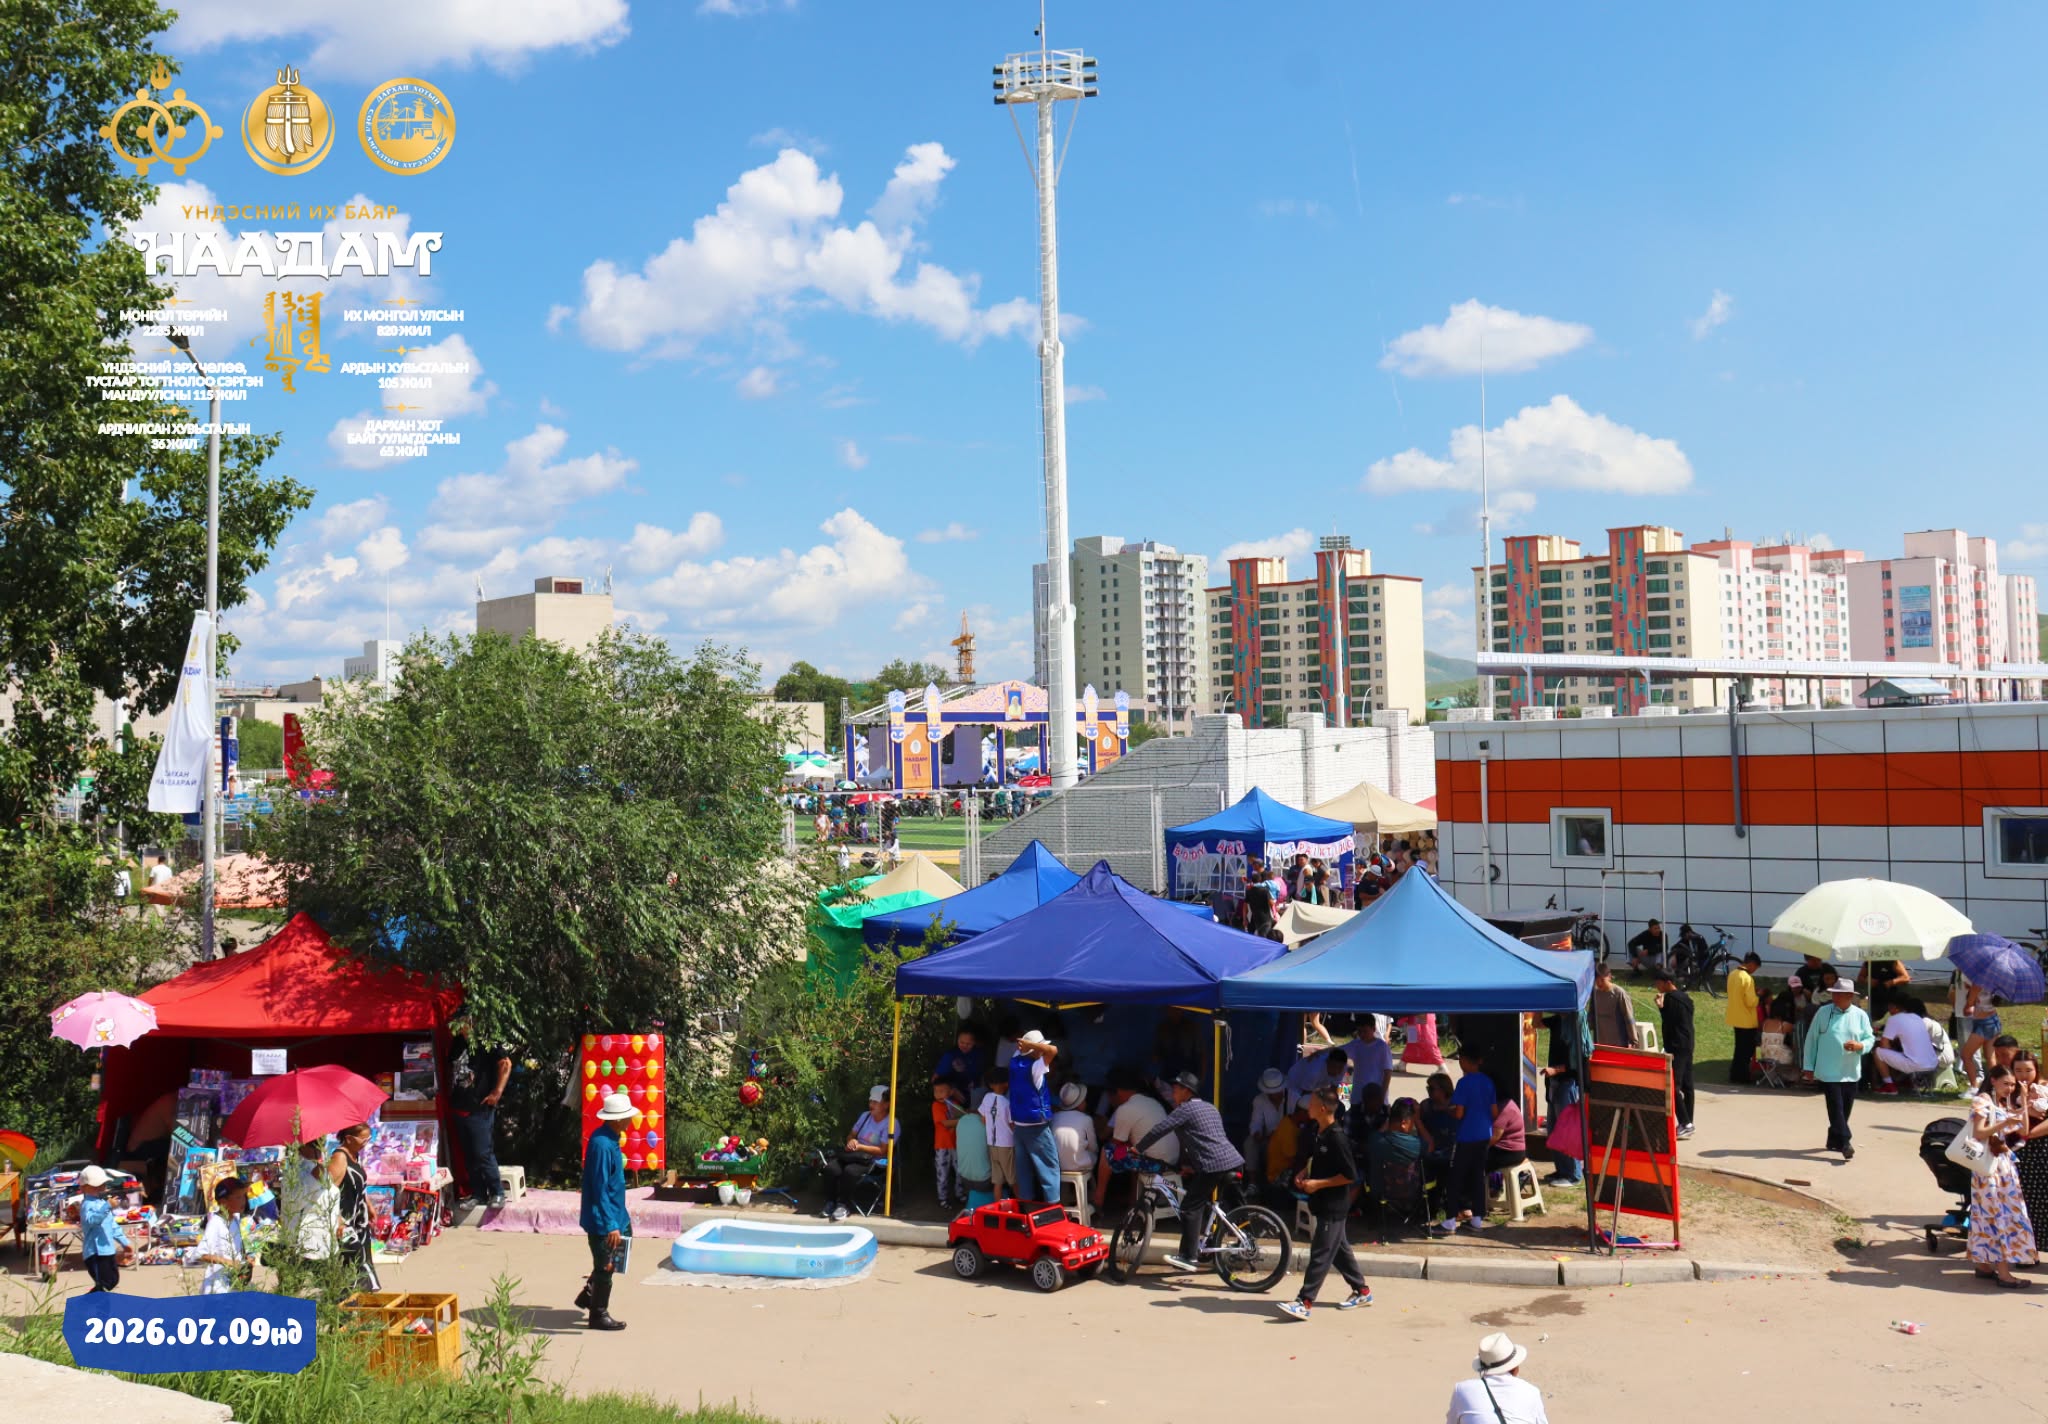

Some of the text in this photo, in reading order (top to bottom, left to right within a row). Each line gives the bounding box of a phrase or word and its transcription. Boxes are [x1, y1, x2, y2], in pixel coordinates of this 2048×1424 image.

[1174, 842, 1243, 861] BODY ART
[1268, 844, 1294, 856] FACE
